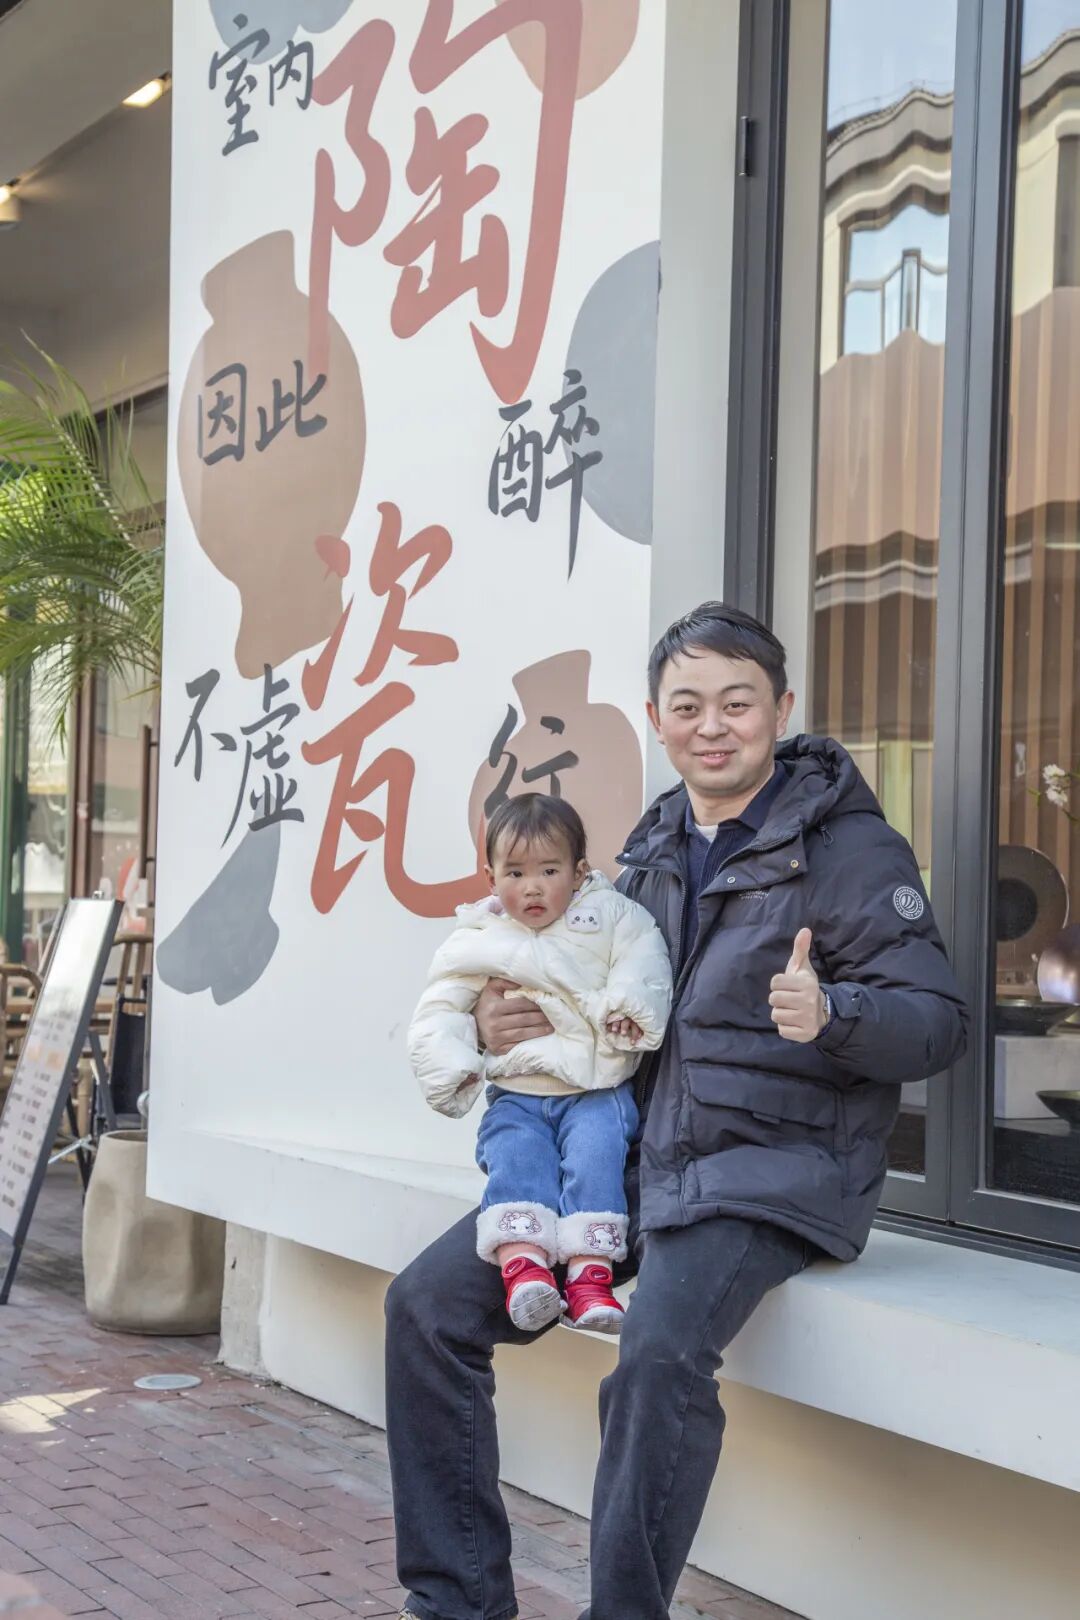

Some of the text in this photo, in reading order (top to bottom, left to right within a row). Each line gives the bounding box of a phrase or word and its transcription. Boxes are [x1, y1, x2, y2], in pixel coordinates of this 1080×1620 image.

[209, 13, 314, 157] 室内
[197, 359, 328, 467] 因此
[487, 368, 604, 582] 醉
[174, 662, 305, 849] 不虚
